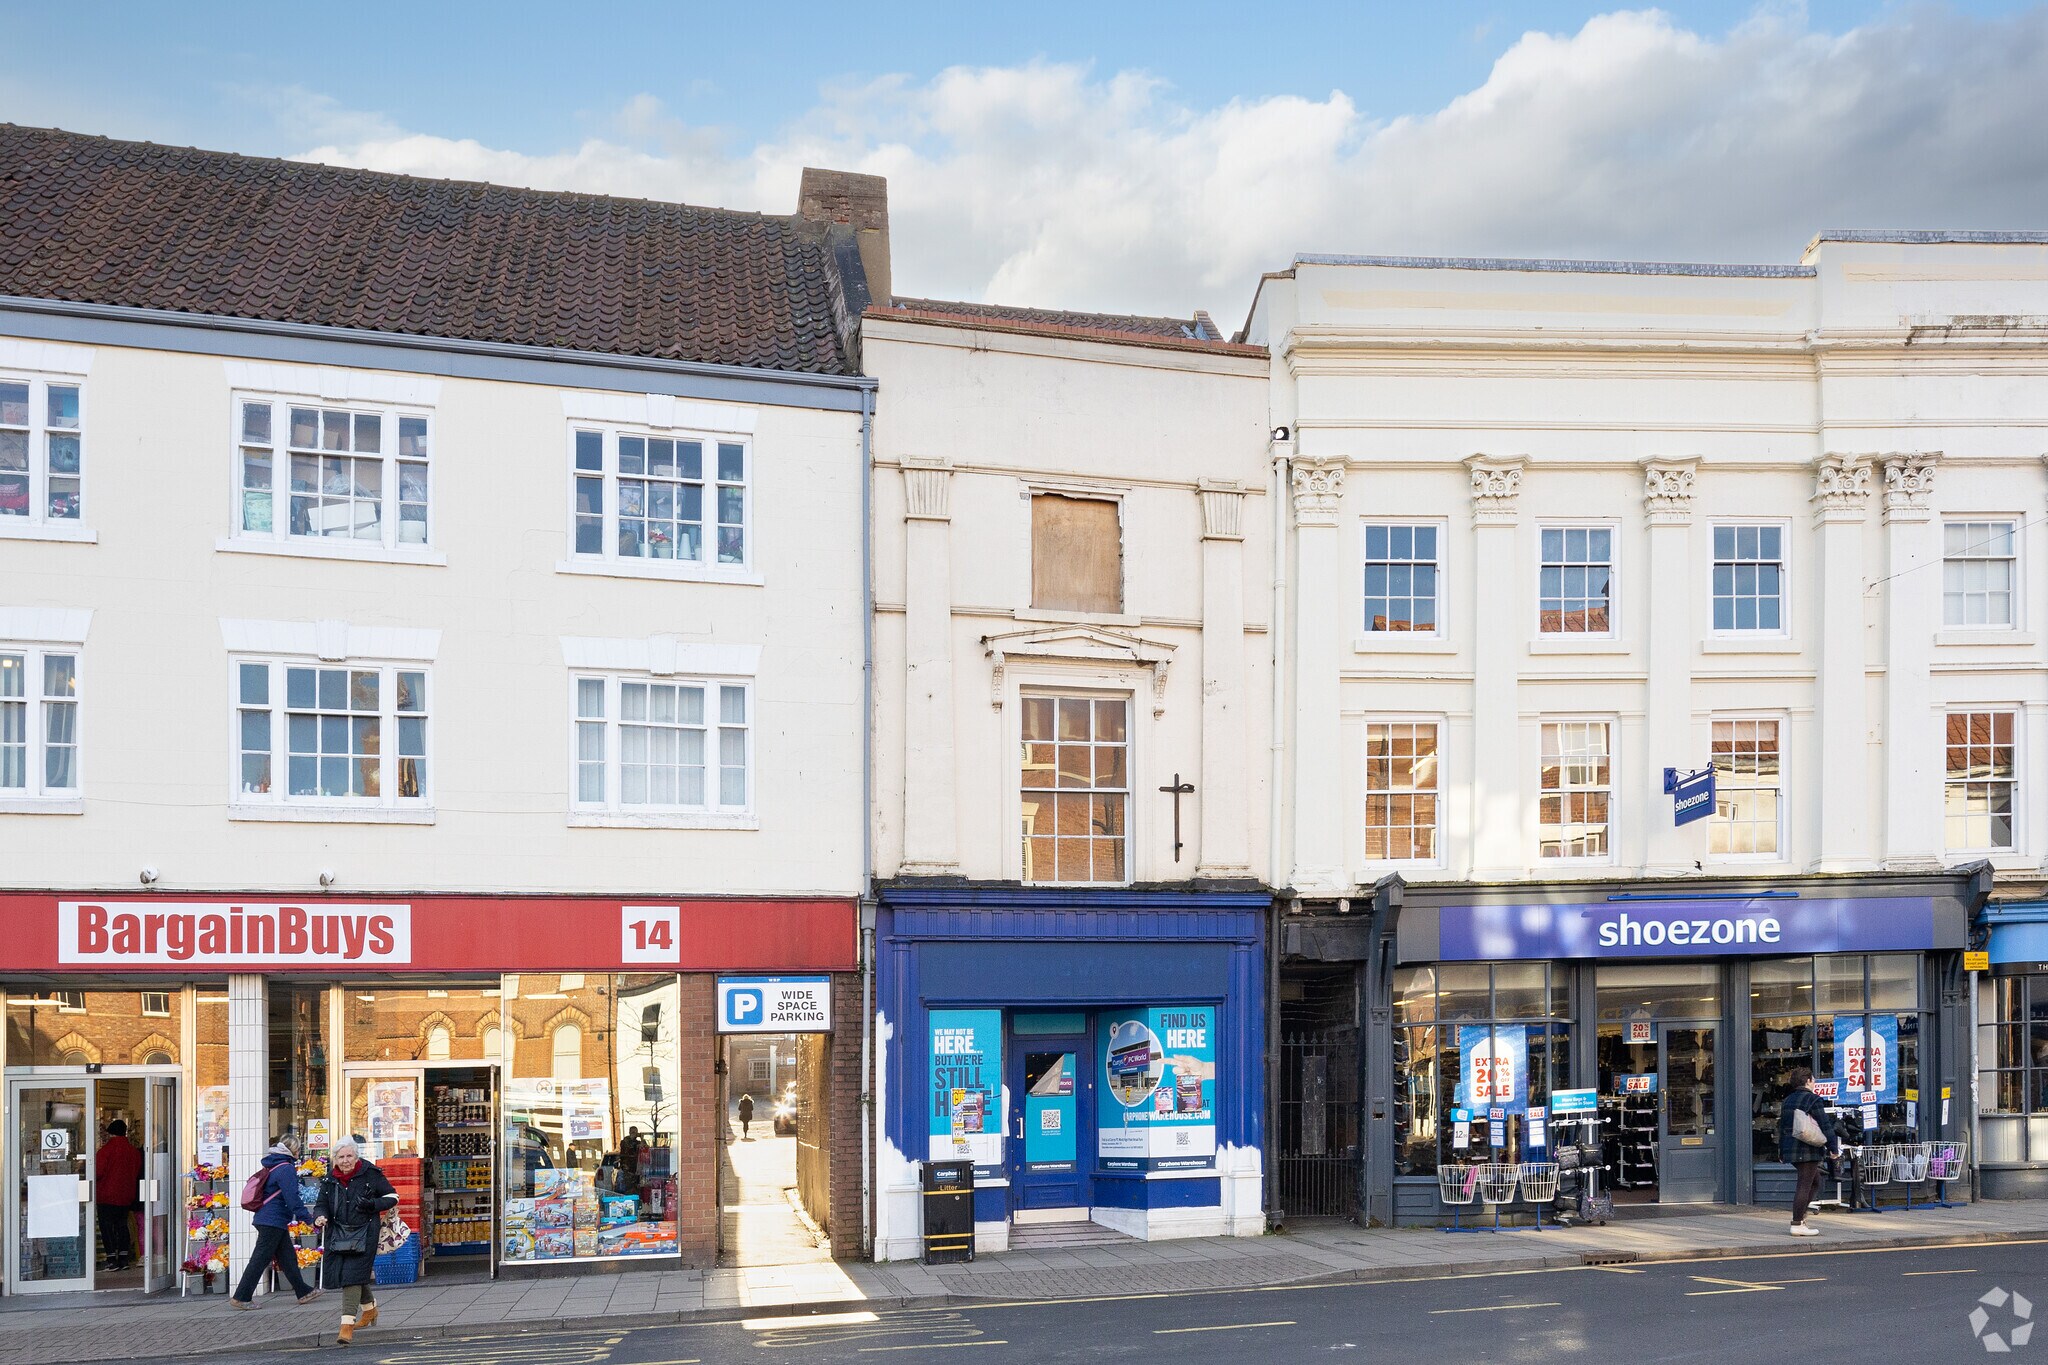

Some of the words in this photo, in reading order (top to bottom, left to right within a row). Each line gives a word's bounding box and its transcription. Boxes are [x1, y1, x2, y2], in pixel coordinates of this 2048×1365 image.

[1675, 790, 1709, 812] shoezone
[77, 905, 395, 960] BargainBuys
[628, 918, 673, 950] 14
[1598, 913, 1781, 947] shoezone
[781, 990, 813, 1000] WIDE
[734, 993, 758, 1020] P
[777, 1001, 818, 1011] SPACE
[770, 1012, 824, 1022] PARKING
[1160, 1013, 1188, 1028] FIND
[1190, 1013, 1206, 1028] US
[1166, 1028, 1206, 1048] HERE
[935, 1055, 951, 1066] BUT
[954, 1054, 983, 1065] WE'RE
[934, 1067, 985, 1089] STILL
[1848, 1074, 1882, 1087] SAE
[1813, 1087, 1837, 1096] SALE
[935, 1090, 993, 1117] HE
